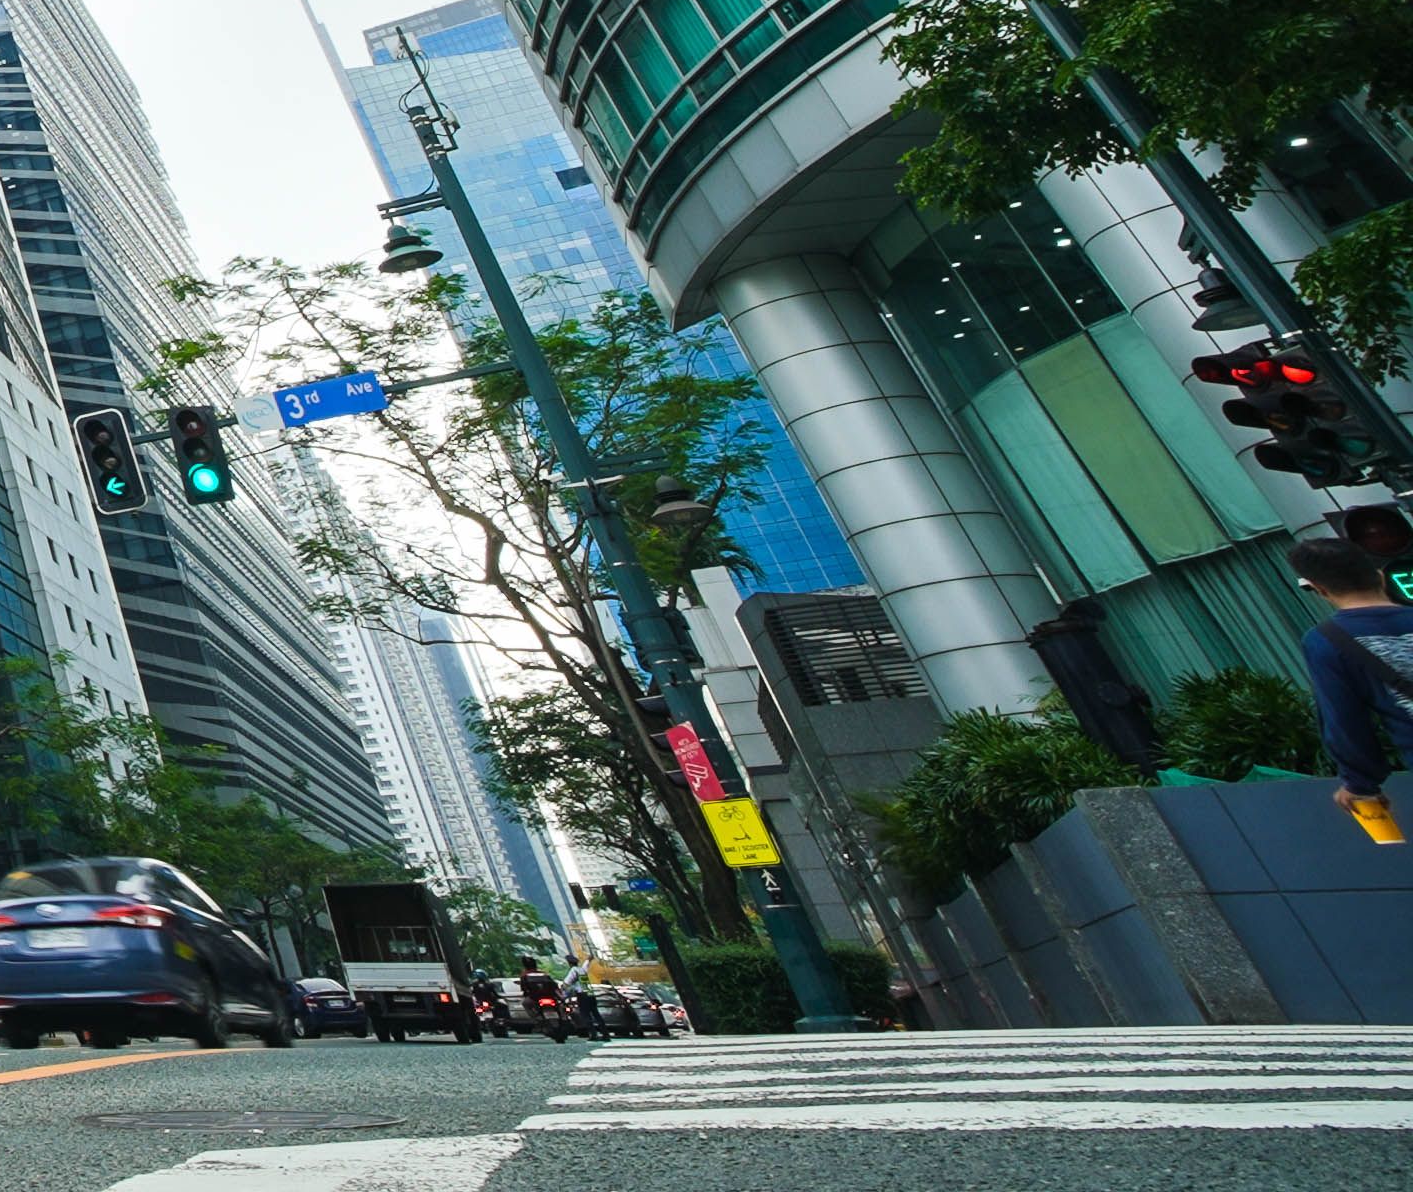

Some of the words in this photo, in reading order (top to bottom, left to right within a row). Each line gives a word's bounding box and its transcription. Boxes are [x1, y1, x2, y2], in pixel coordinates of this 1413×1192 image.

[284, 390, 321, 420] 3rd
[346, 381, 373, 397] Ave
[742, 843, 769, 852] SCOOTER
